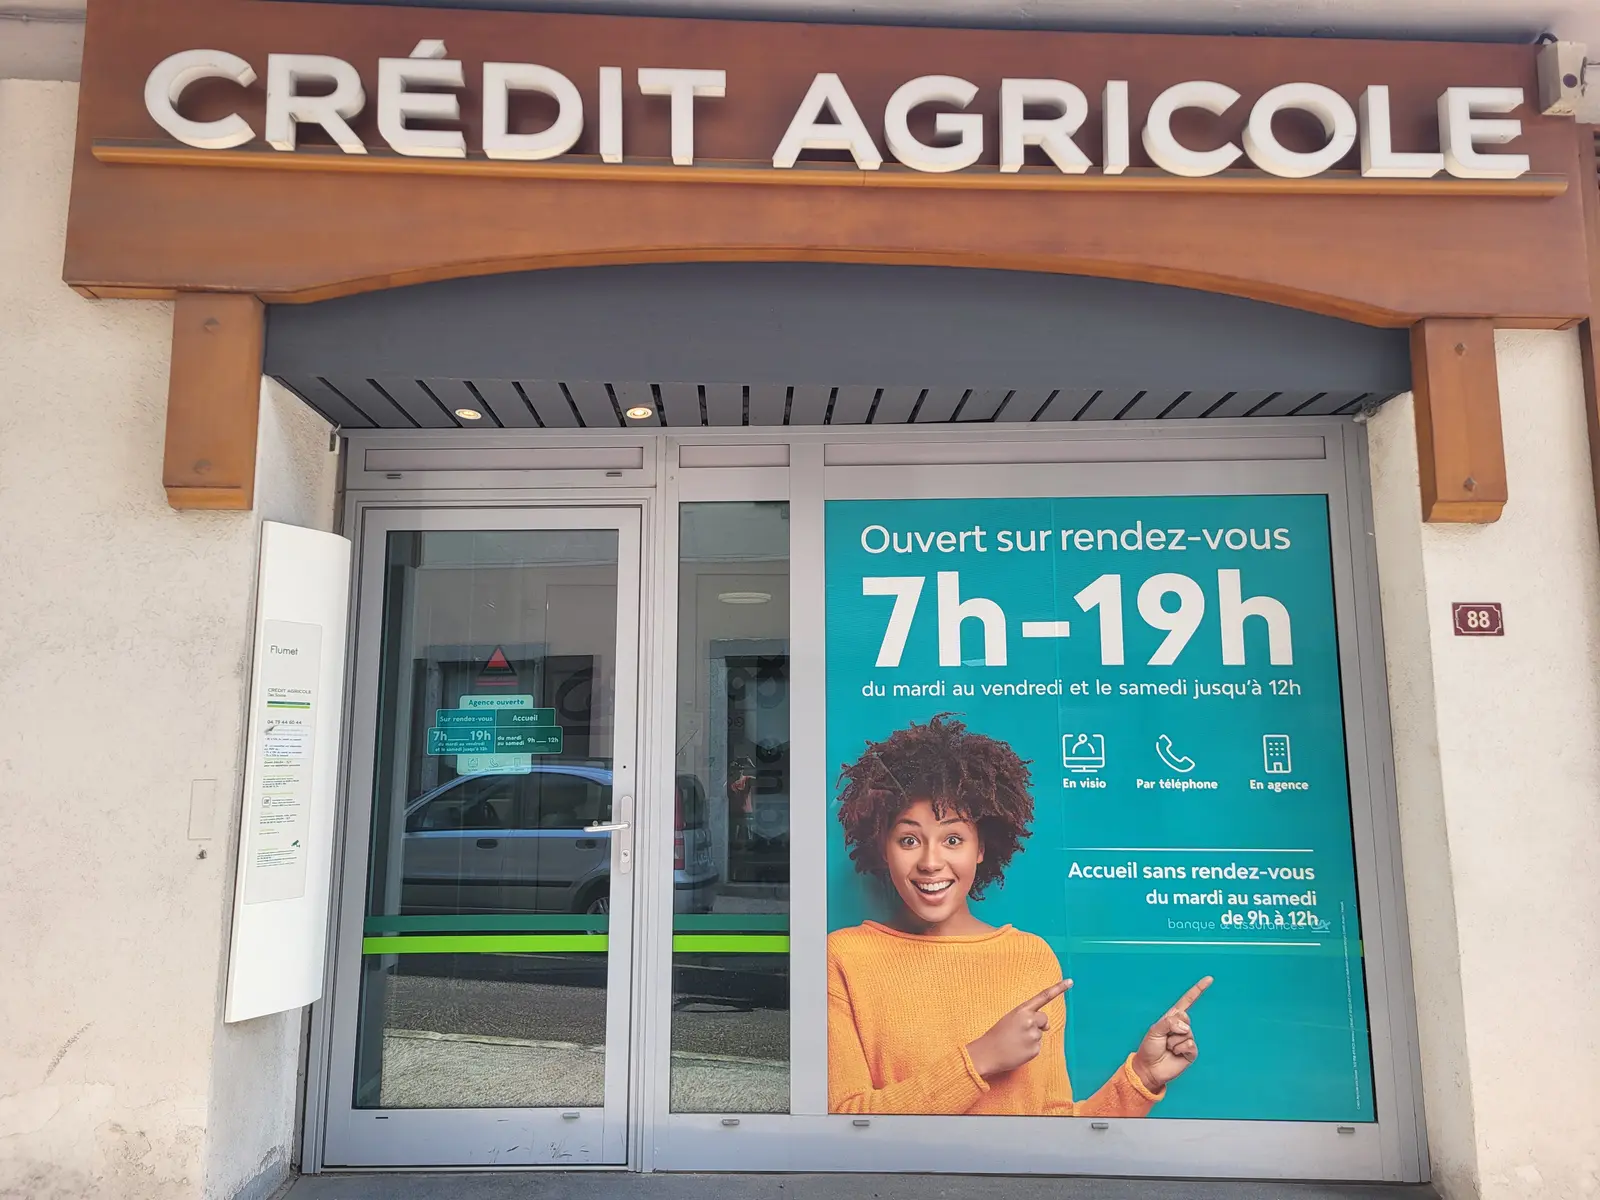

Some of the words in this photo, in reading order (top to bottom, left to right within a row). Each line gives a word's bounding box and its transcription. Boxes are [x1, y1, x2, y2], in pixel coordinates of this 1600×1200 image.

[144, 39, 727, 166] CRÉDIT
[772, 72, 1531, 180] AGRICOLE
[860, 524, 988, 554] Ouvert
[996, 528, 1052, 552] sur
[1061, 520, 1292, 552] rendez-vous
[1466, 610, 1491, 628] 88
[270, 645, 299, 656] Flumet
[861, 681, 886, 697] du
[893, 680, 946, 697] mardi
[952, 683, 975, 696] au
[981, 679, 1063, 696] vendredi
[1069, 680, 1090, 696] et
[1096, 679, 1112, 695] le
[1119, 679, 1188, 696] samedi
[1193, 679, 1262, 700] jusqu'à
[1268, 679, 1302, 696] 12h
[469, 699, 495, 708] Agence
[512, 714, 539, 722] Accueil
[433, 730, 448, 741] 7h
[470, 730, 491, 741] 19h
[1063, 778, 1077, 788] En
[1080, 777, 1107, 789] visio
[1136, 778, 1155, 789] Par
[1159, 778, 1219, 793] téléphone
[1250, 780, 1264, 790] En
[1267, 780, 1309, 793] agence
[1068, 861, 1138, 879] Accueil
[1143, 866, 1186, 880] sans
[1192, 863, 1316, 880] rendez-vous
[1146, 889, 1169, 905] du
[1174, 889, 1223, 905] mardi
[1228, 893, 1248, 906] au
[1253, 890, 1317, 906] samedi
[1167, 918, 1216, 932] banque
[1233, 920, 1305, 931] assurances
[1221, 910, 1244, 926] de
[1247, 910, 1270, 926] 9h
[1274, 910, 1285, 926] à
[1288, 911, 1319, 926] 12h
